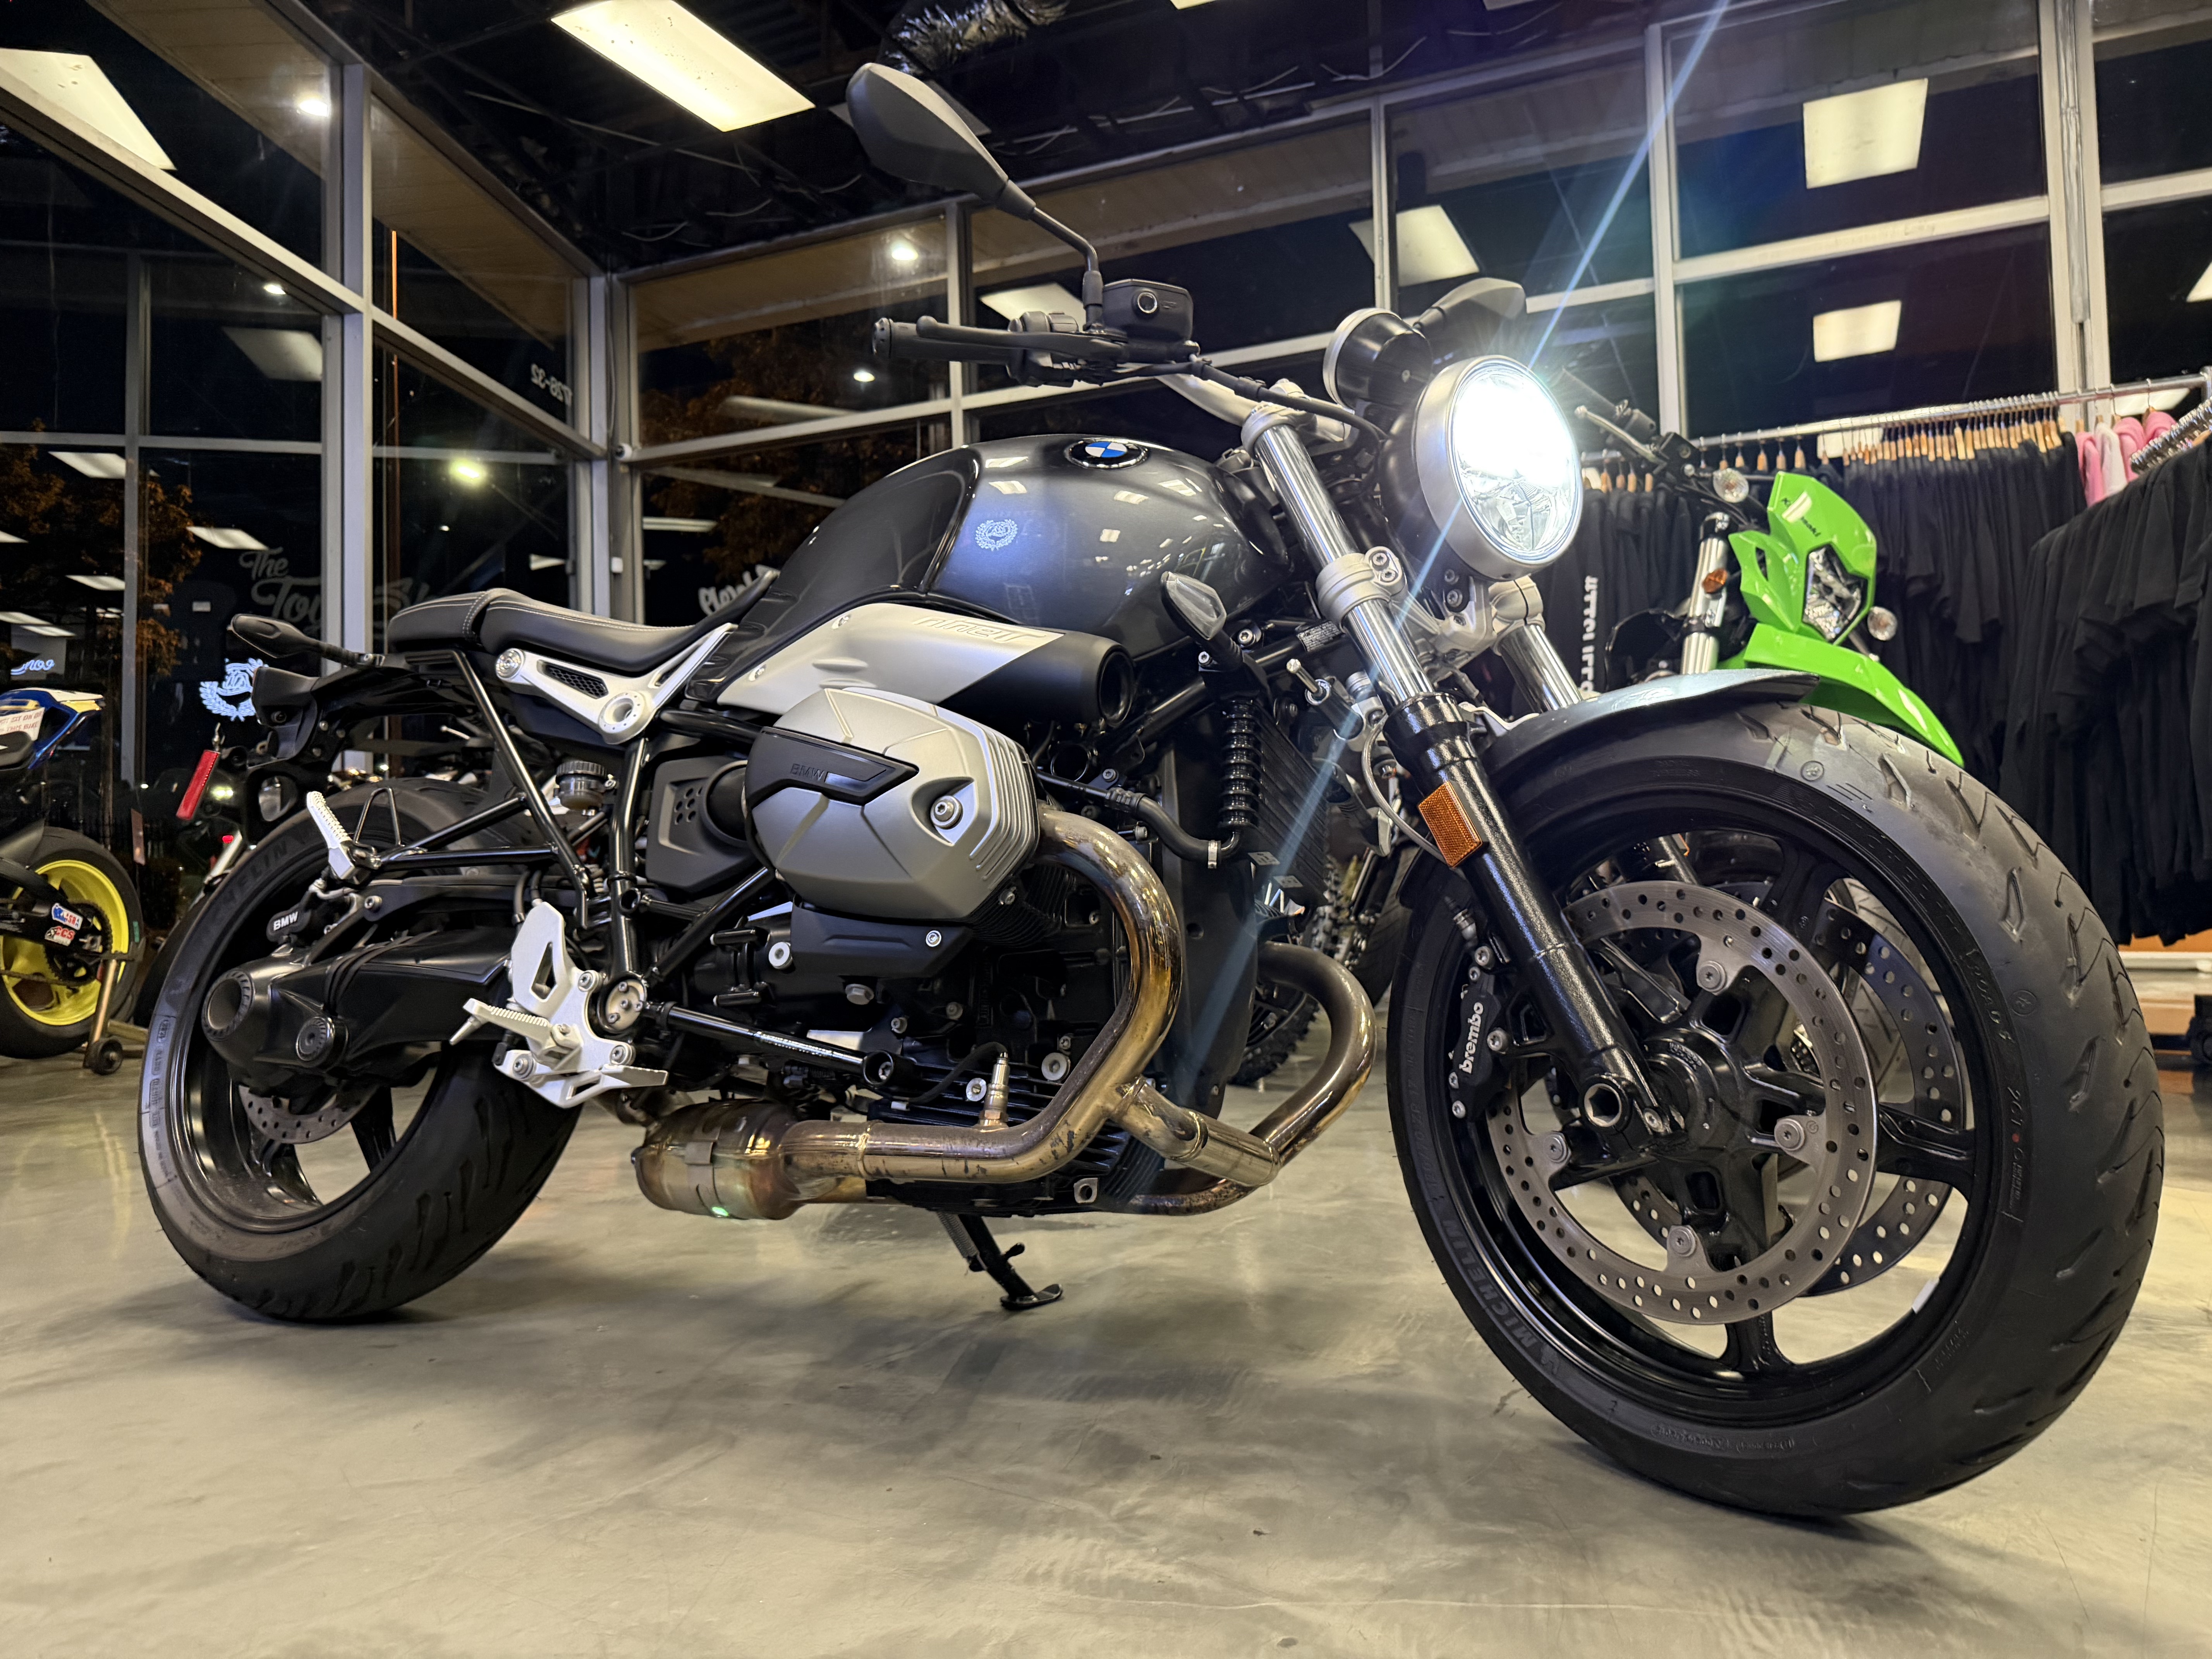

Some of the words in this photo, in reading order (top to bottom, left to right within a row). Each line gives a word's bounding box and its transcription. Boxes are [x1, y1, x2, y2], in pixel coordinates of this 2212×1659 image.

[238, 546, 289, 580] The
[790, 763, 824, 781] BMW
[55, 927, 74, 939] CCS
[273, 911, 298, 931] BMW
[1459, 1002, 1484, 1074] brembo
[1442, 1220, 1538, 1348] MICHELIN
